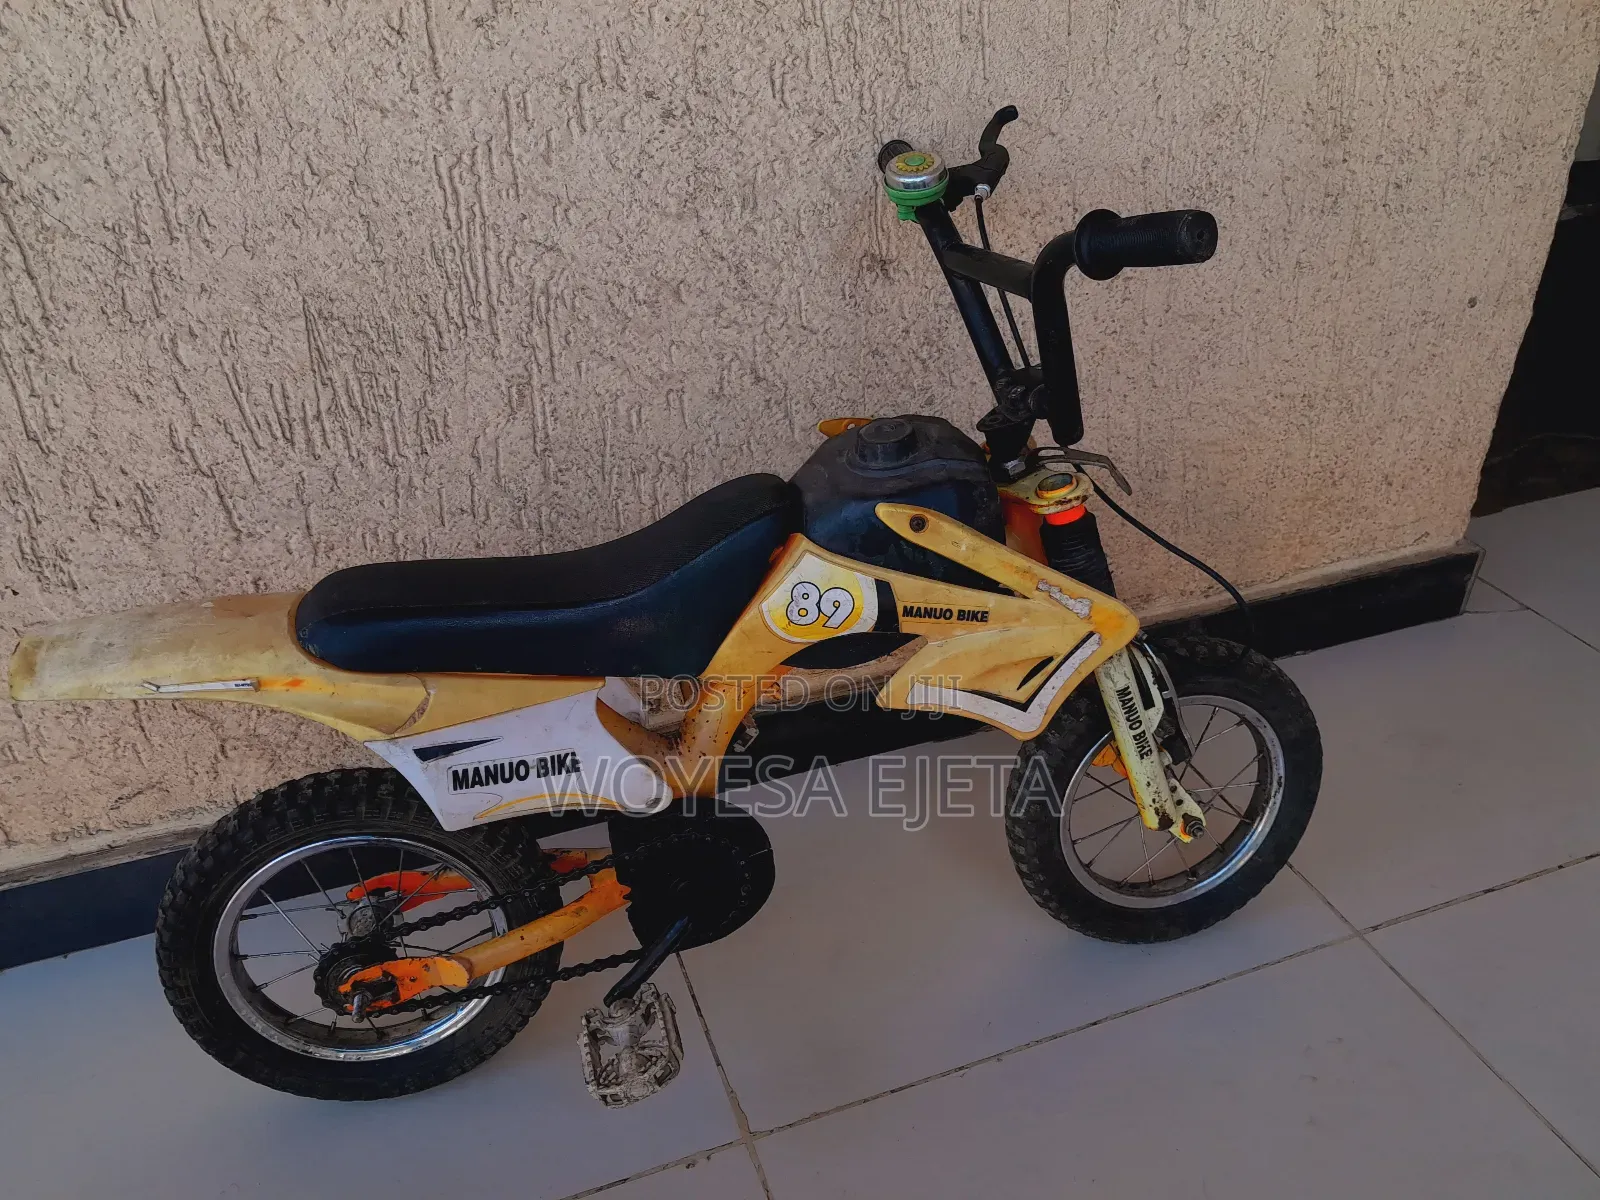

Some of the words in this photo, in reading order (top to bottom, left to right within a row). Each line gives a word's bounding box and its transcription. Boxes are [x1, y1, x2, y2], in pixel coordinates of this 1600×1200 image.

[786, 581, 855, 629] 89
[902, 605, 953, 620] MANUO
[957, 609, 989, 623] BIKE
[1115, 685, 1143, 731] MANUO
[1132, 729, 1153, 760] BIKE
[452, 759, 530, 791] MANUO
